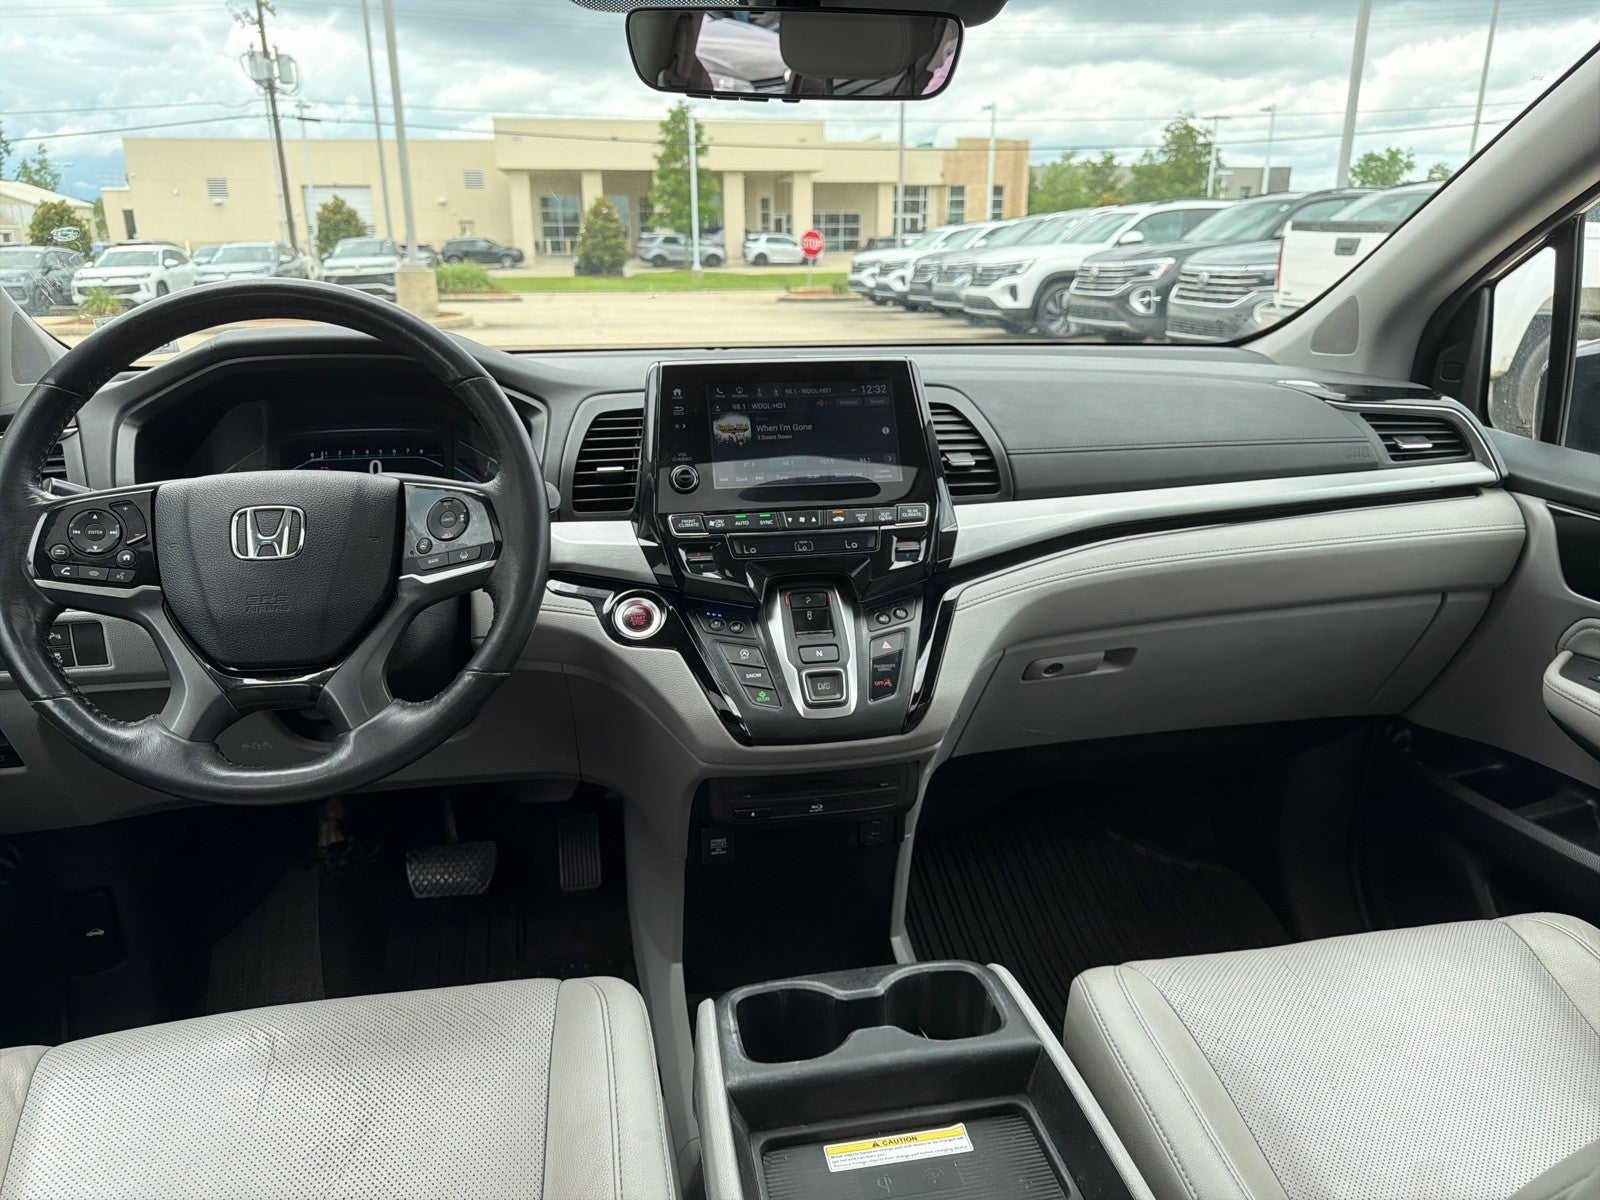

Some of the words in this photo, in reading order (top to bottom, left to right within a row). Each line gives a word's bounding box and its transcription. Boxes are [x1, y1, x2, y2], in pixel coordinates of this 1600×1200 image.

[803, 237, 821, 250] STOP
[861, 384, 887, 394] 12:32
[751, 402, 787, 411] WDGL-HD1
[756, 423, 778, 432] When
[779, 422, 792, 431] I'm
[792, 422, 813, 431] Gone
[369, 459, 383, 474] 0
[743, 545, 757, 554] Lo
[844, 540, 858, 549] Lo
[817, 682, 831, 691] D/S
[882, 1136, 918, 1146] CAUTION
